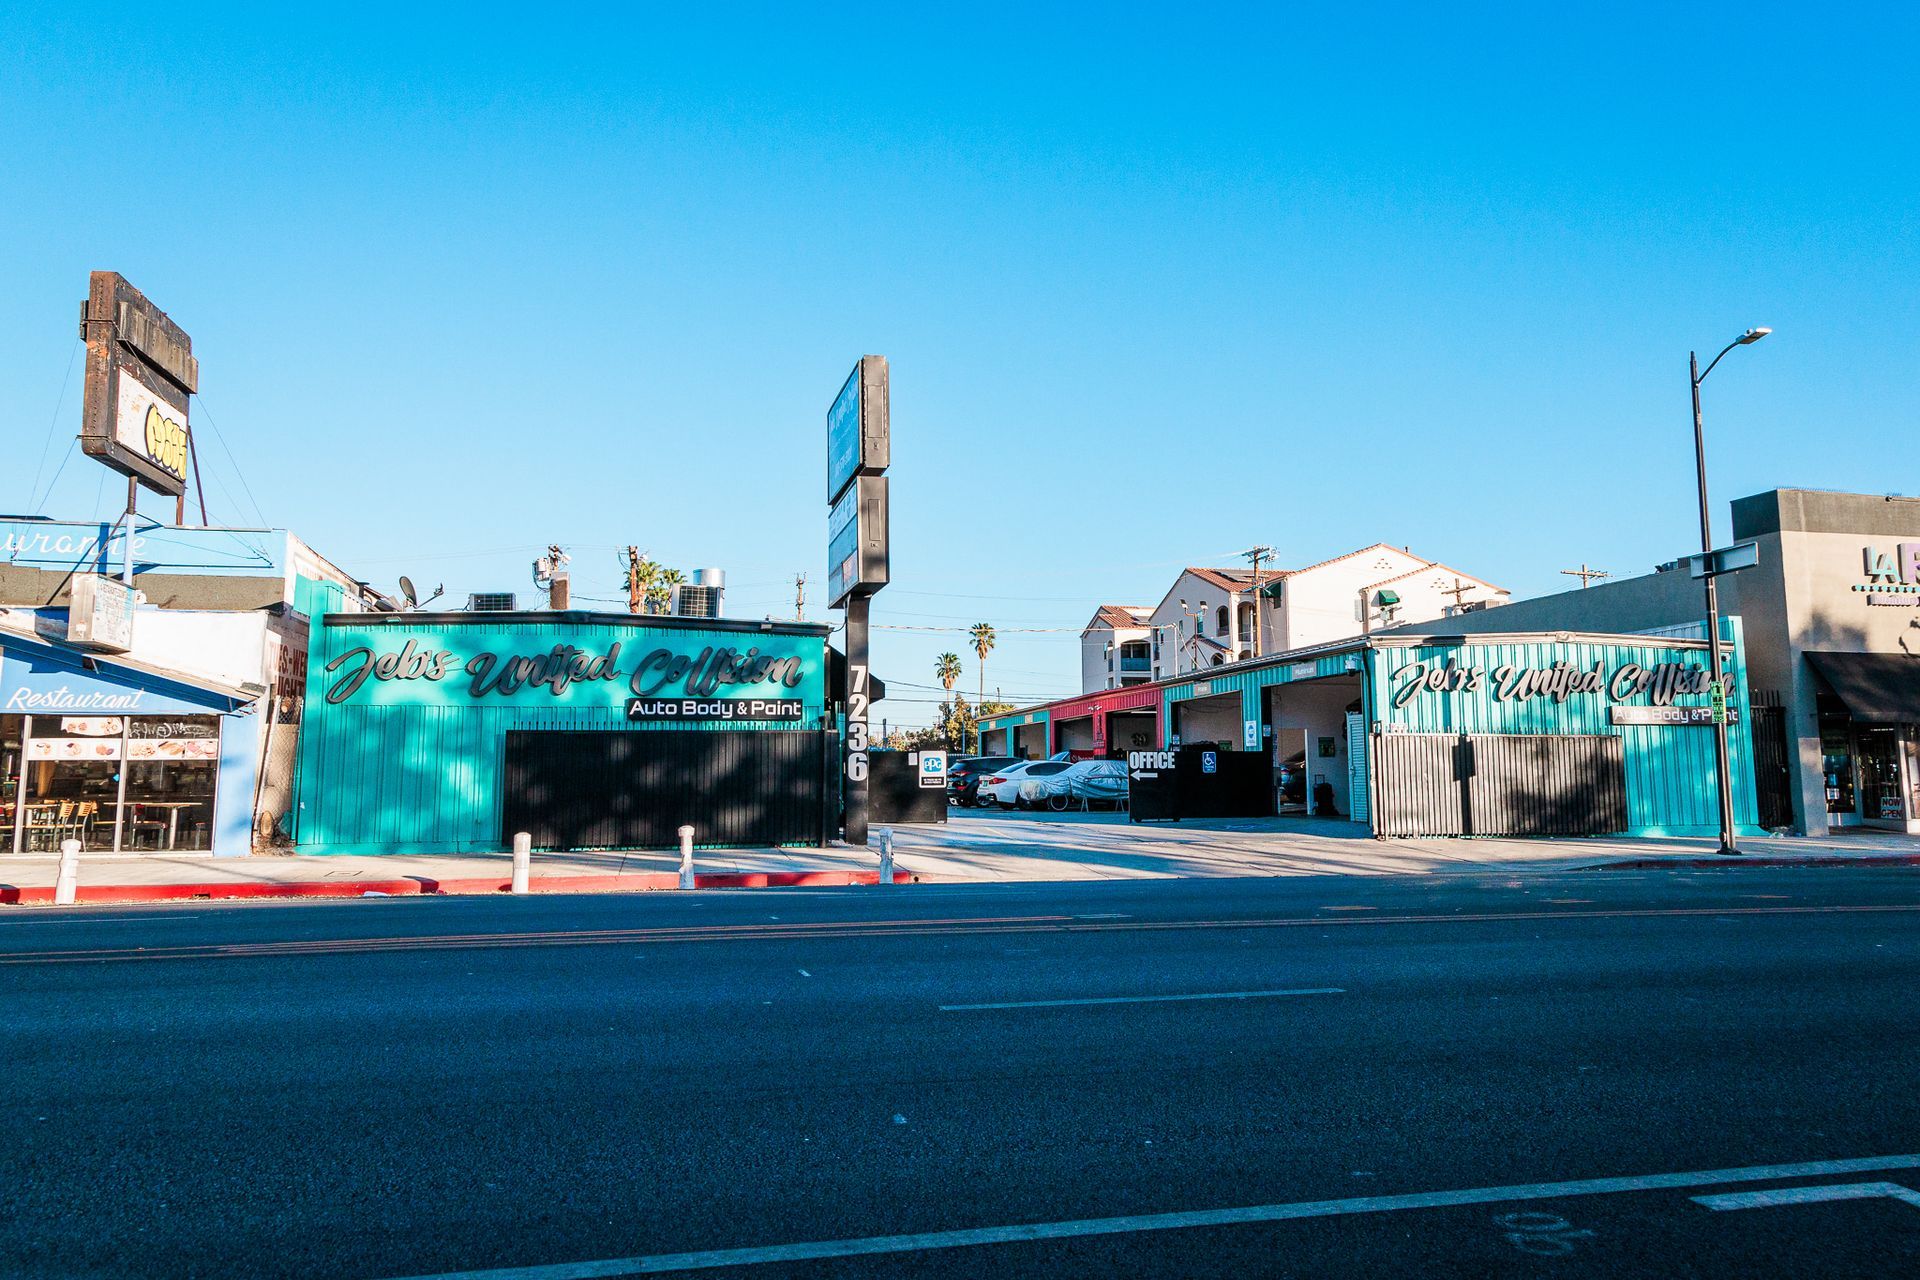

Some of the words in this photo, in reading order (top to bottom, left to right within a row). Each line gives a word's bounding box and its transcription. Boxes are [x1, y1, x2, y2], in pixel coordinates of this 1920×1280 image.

[326, 639, 460, 703] Jeb's
[465, 642, 622, 697] United
[629, 646, 803, 697] Collision
[1394, 658, 1486, 708] Jeb's
[1495, 660, 1605, 703] United
[6, 686, 145, 711] Restaurant
[630, 701, 678, 716] Auto
[683, 700, 734, 719] Body
[737, 702, 747, 715] &
[751, 700, 801, 715] Paint
[1652, 708, 1688, 723] Body
[1691, 709, 1699, 720] &
[1701, 709, 1738, 720] Pnt
[848, 666, 868, 781] 7236
[924, 758, 942, 770] PPG
[1130, 751, 1176, 770] OFFICE
[1881, 809, 1903, 818] OPEN
